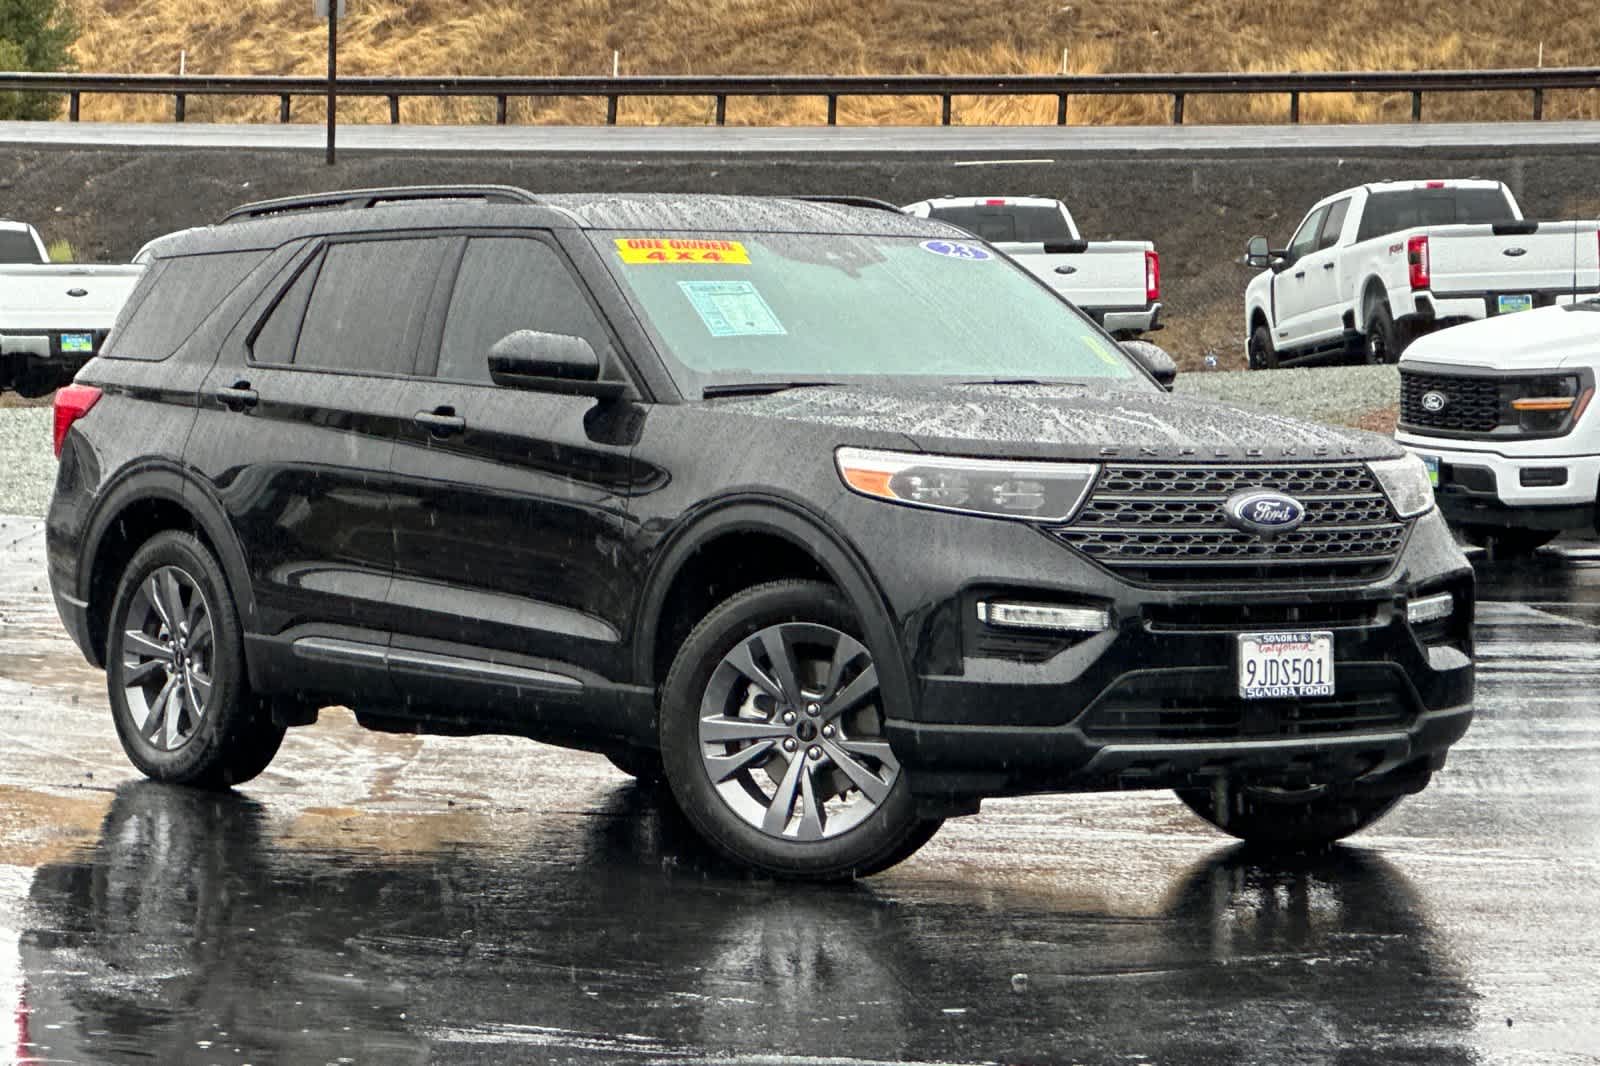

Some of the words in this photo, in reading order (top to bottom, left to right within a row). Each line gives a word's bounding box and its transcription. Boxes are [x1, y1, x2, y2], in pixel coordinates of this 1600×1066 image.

[1253, 501, 1290, 521] Ford
[1263, 634, 1298, 643] SONORA
[1247, 658, 1325, 686] 9JDS501
[1247, 687, 1296, 697] SONORA
[1299, 686, 1329, 696] FORD
